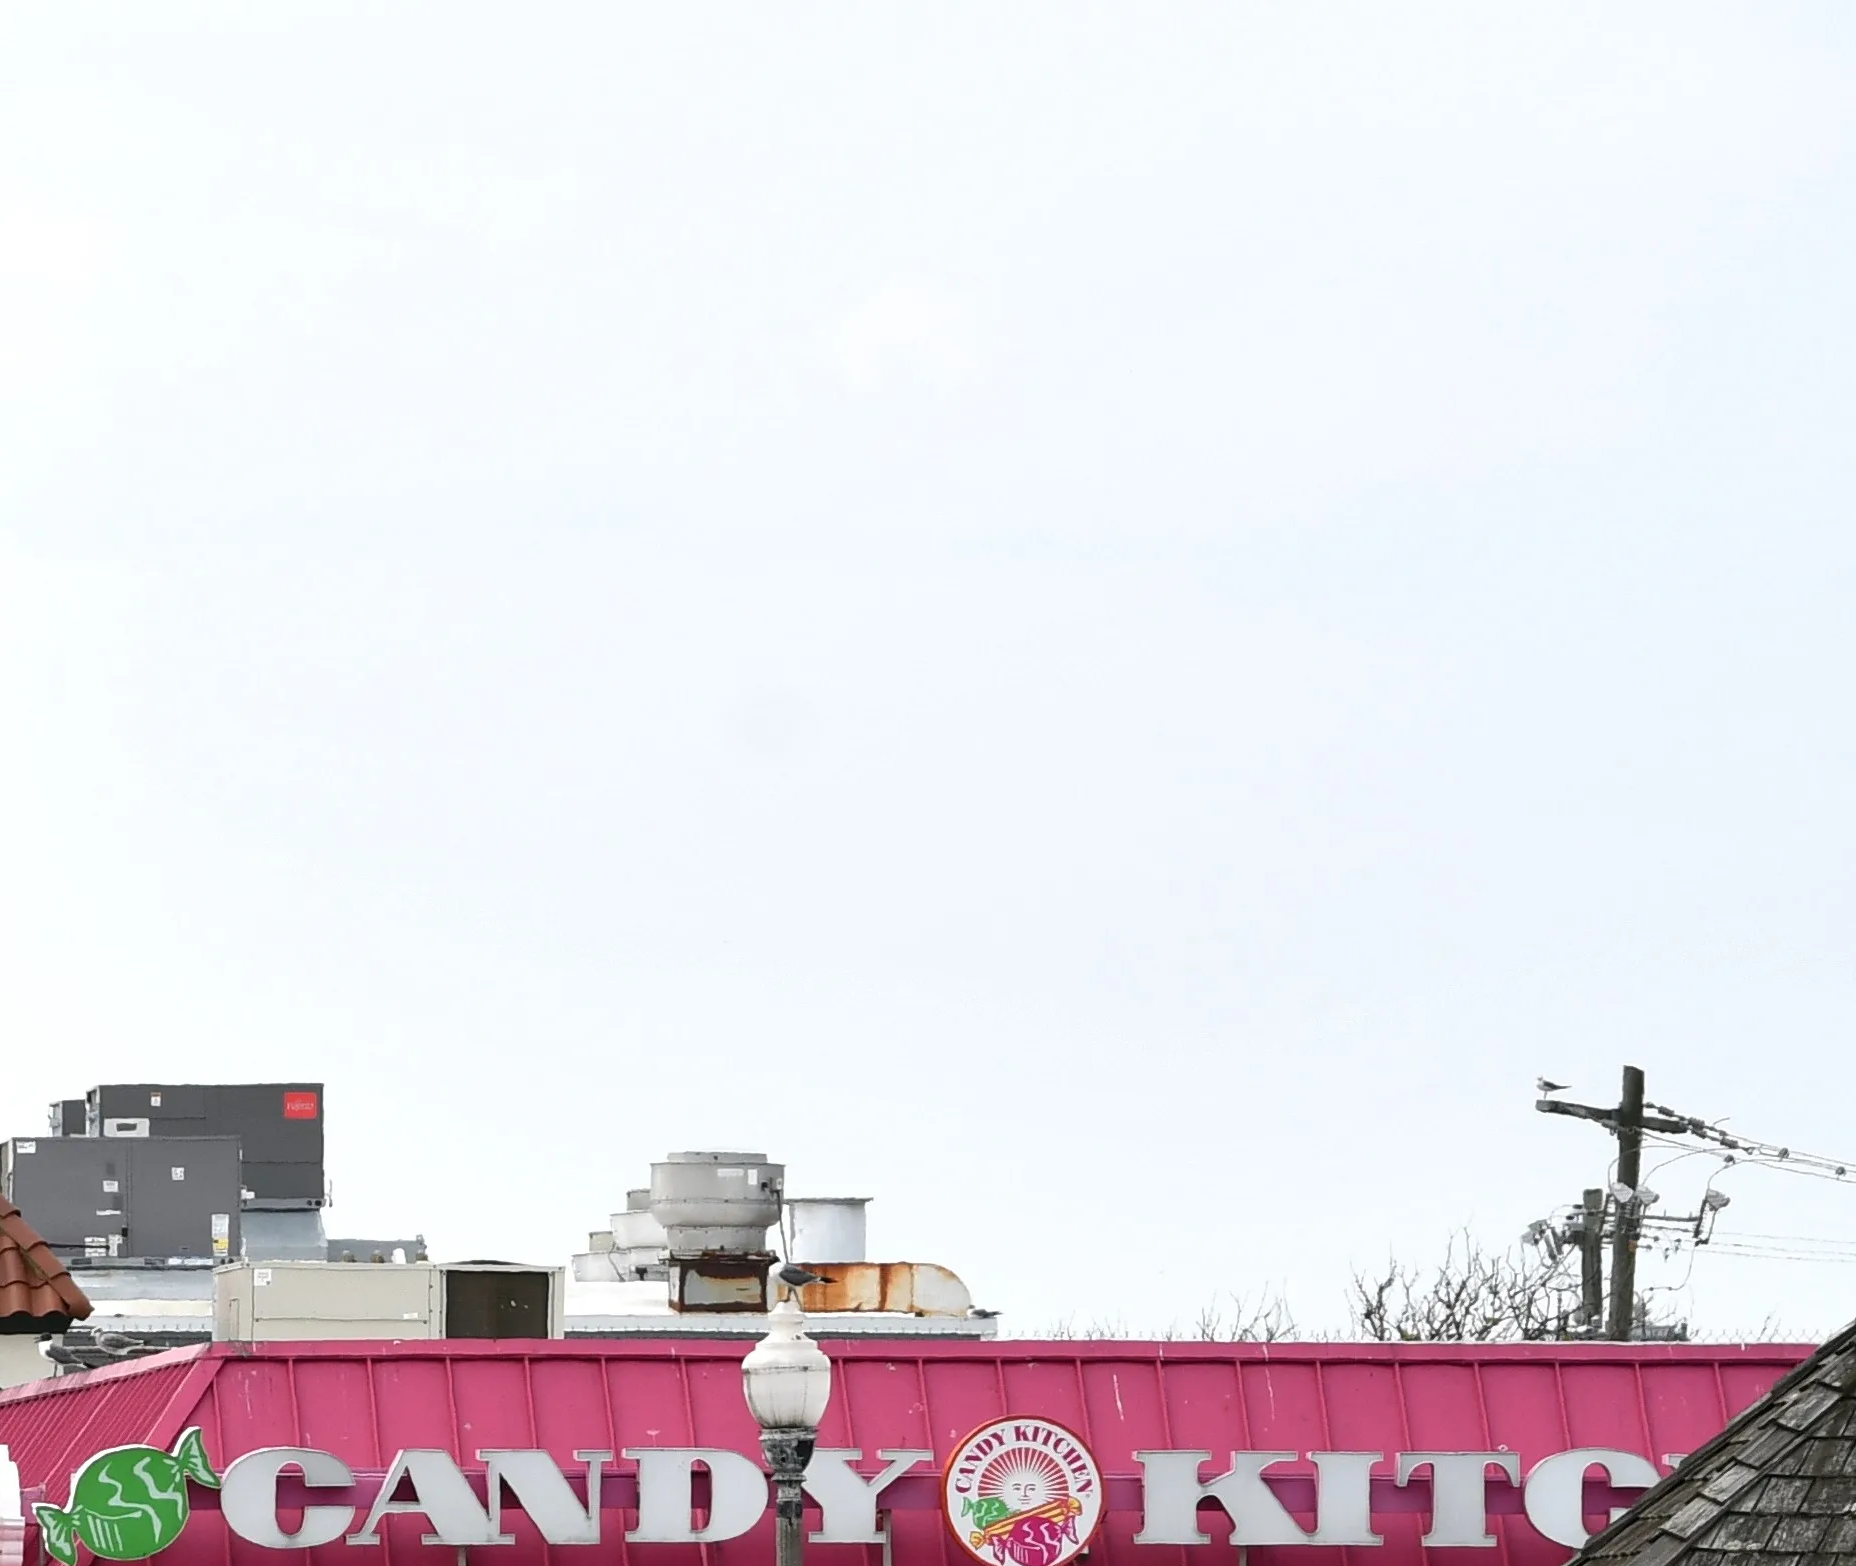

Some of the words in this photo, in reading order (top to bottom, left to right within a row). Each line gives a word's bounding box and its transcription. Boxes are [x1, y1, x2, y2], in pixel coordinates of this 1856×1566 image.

[219, 1445, 935, 1550] CANDY
[1131, 1446, 1689, 1551] KITC
[954, 1428, 1007, 1495] CANDY
[1013, 1424, 1095, 1494] KITCHEN
